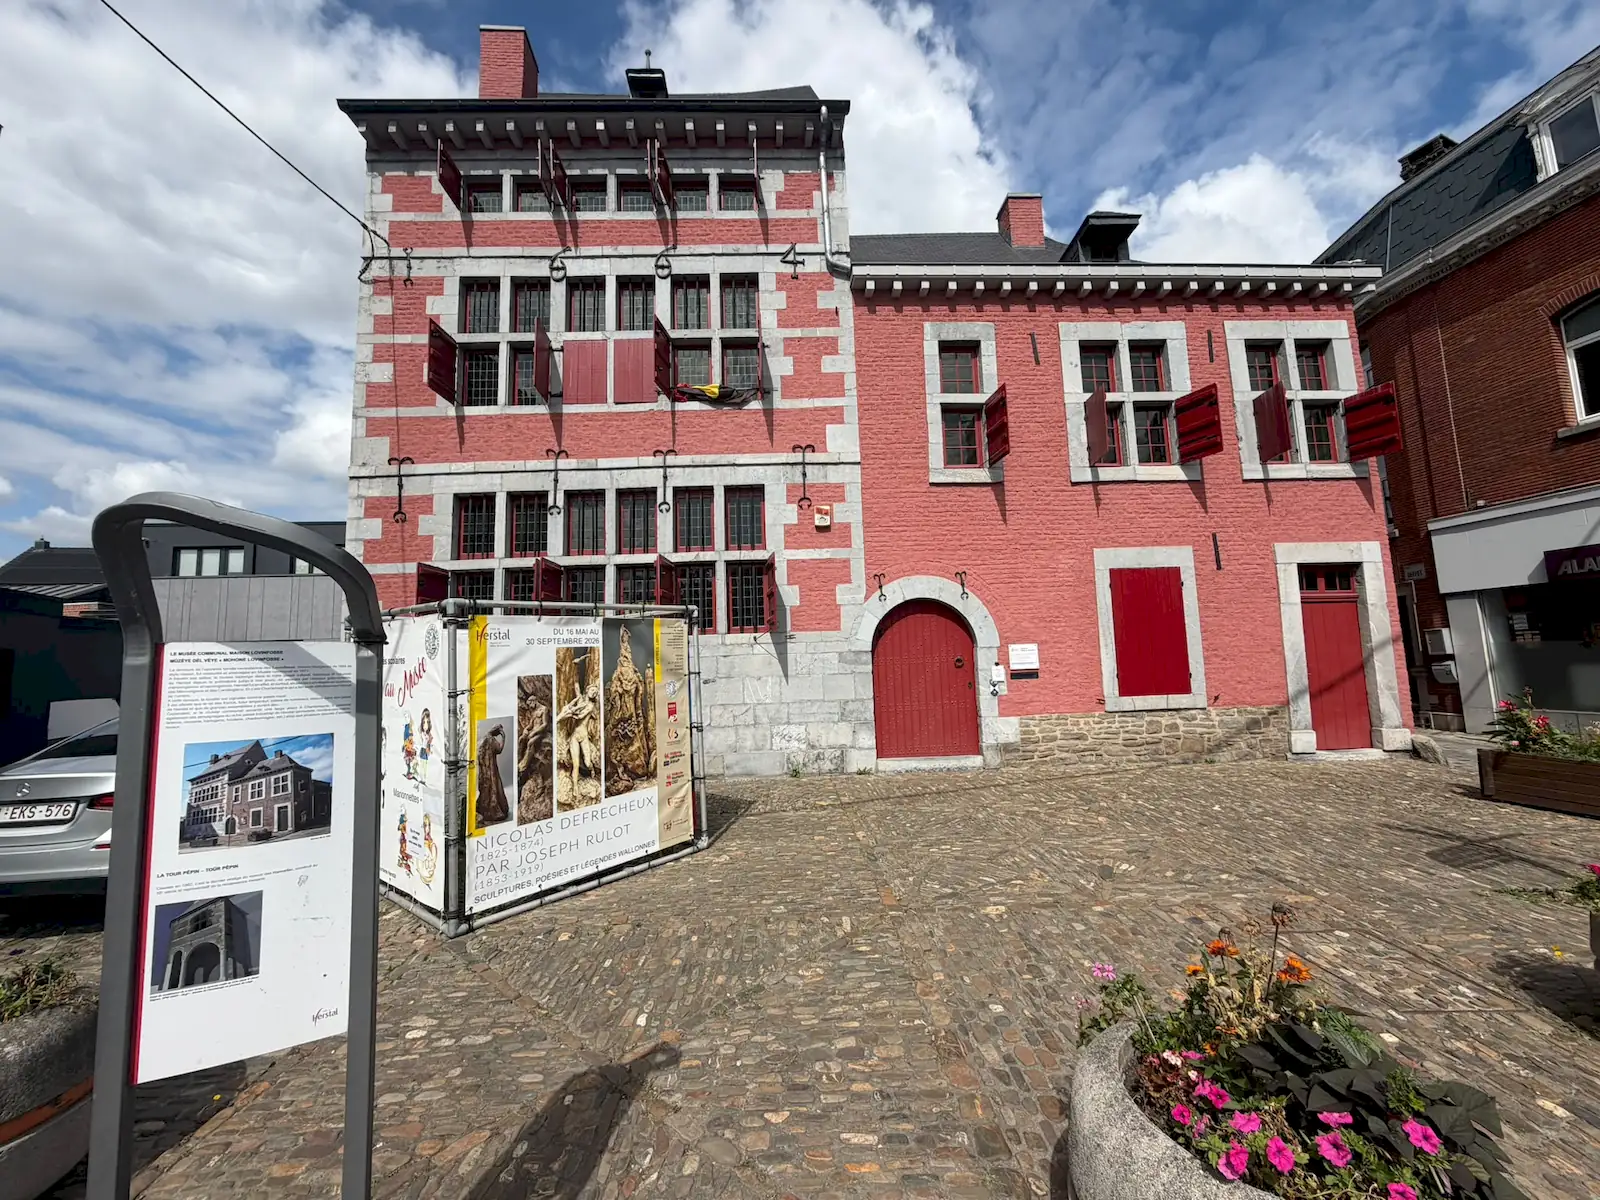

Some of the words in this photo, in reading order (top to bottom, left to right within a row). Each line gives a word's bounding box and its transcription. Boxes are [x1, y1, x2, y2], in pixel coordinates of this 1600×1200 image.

[476, 623, 510, 646] Herstal
[553, 628, 564, 636] DU
[584, 637, 600, 645] 2026
[476, 821, 553, 852] NICOLAS
[560, 796, 654, 830] DEFRECHEUX
[475, 837, 544, 863] (1825-1874)
[476, 859, 510, 879] PAR
[517, 838, 579, 868] JOSEPH
[586, 823, 631, 846] RULOT
[535, 867, 569, 884] POÉSIES
[570, 864, 580, 873] ET
[580, 852, 617, 870] LÉGENDES
[617, 840, 656, 857] WALLONNES
[474, 863, 544, 891] (1853-1919)
